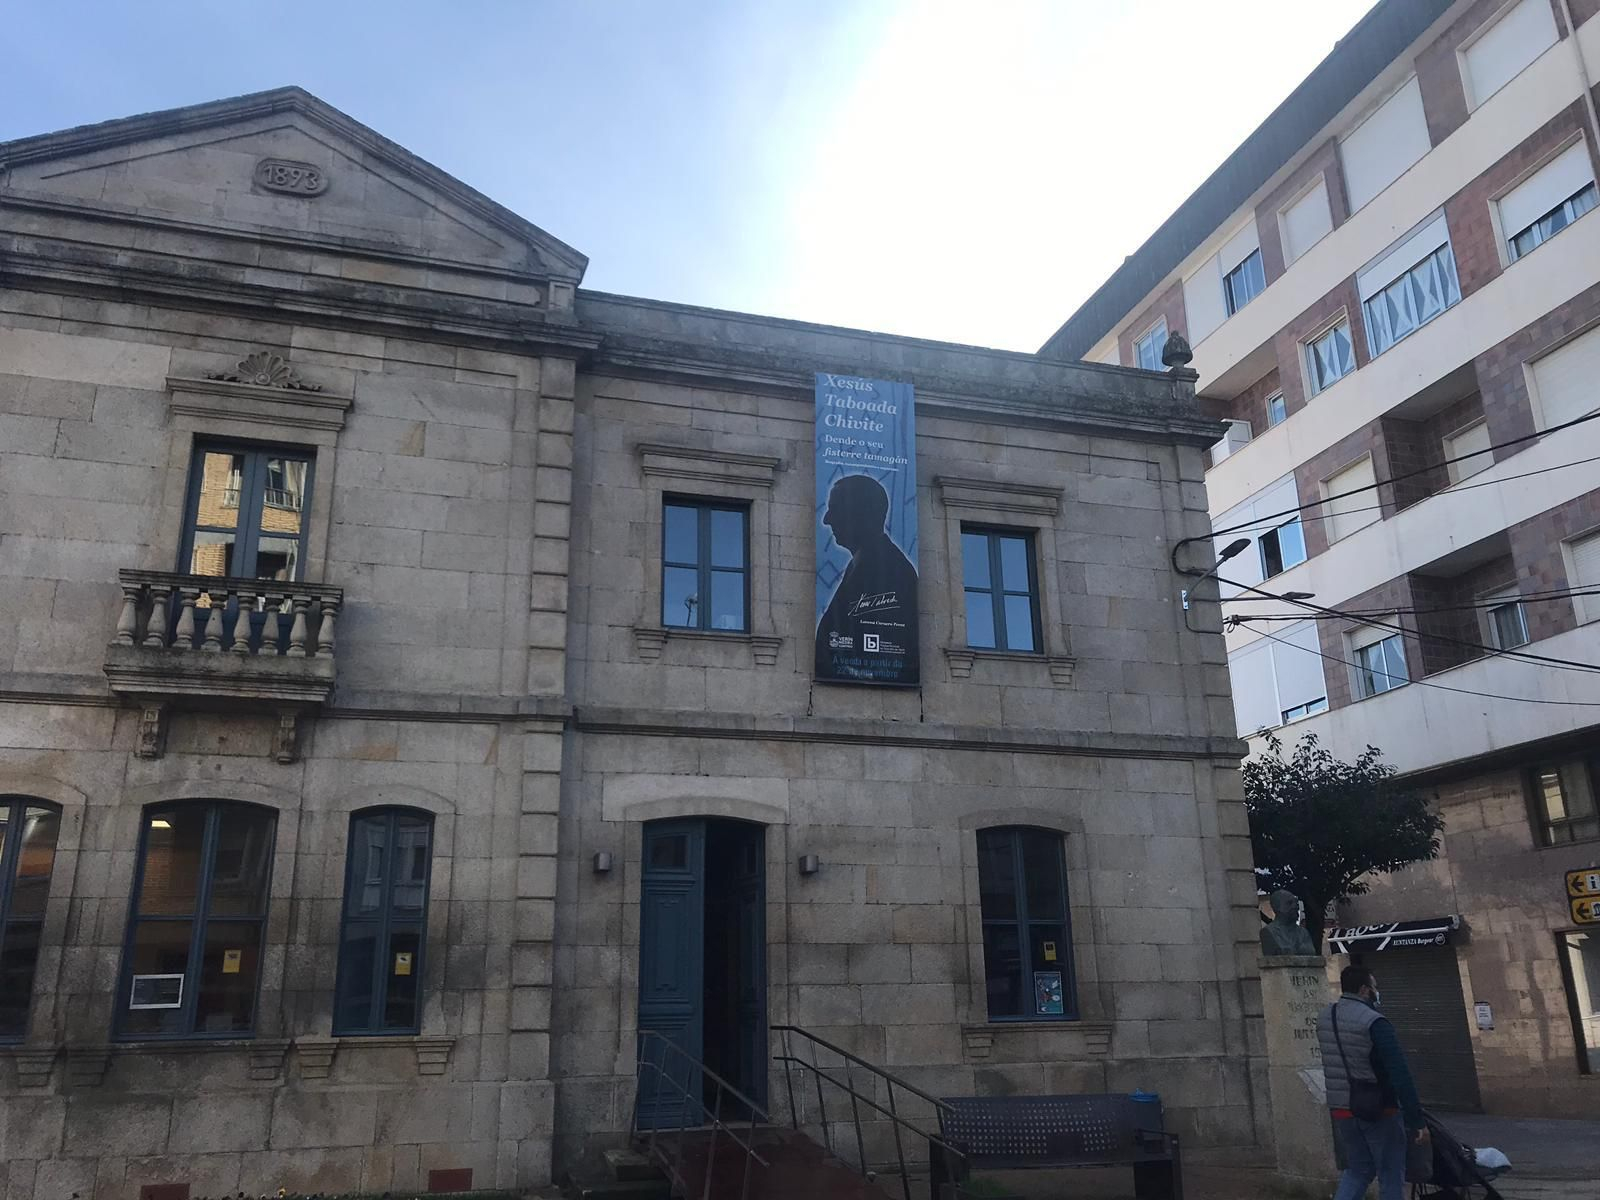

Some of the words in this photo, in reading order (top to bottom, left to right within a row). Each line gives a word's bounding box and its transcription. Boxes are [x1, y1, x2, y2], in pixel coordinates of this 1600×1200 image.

[263, 164, 318, 191] 1893
[824, 374, 873, 391] Xesús
[825, 394, 897, 415] Taboada
[825, 414, 884, 432] Chivite
[825, 434, 857, 446] Dende
[867, 441, 884, 449] seu
[822, 447, 862, 458] fisterre
